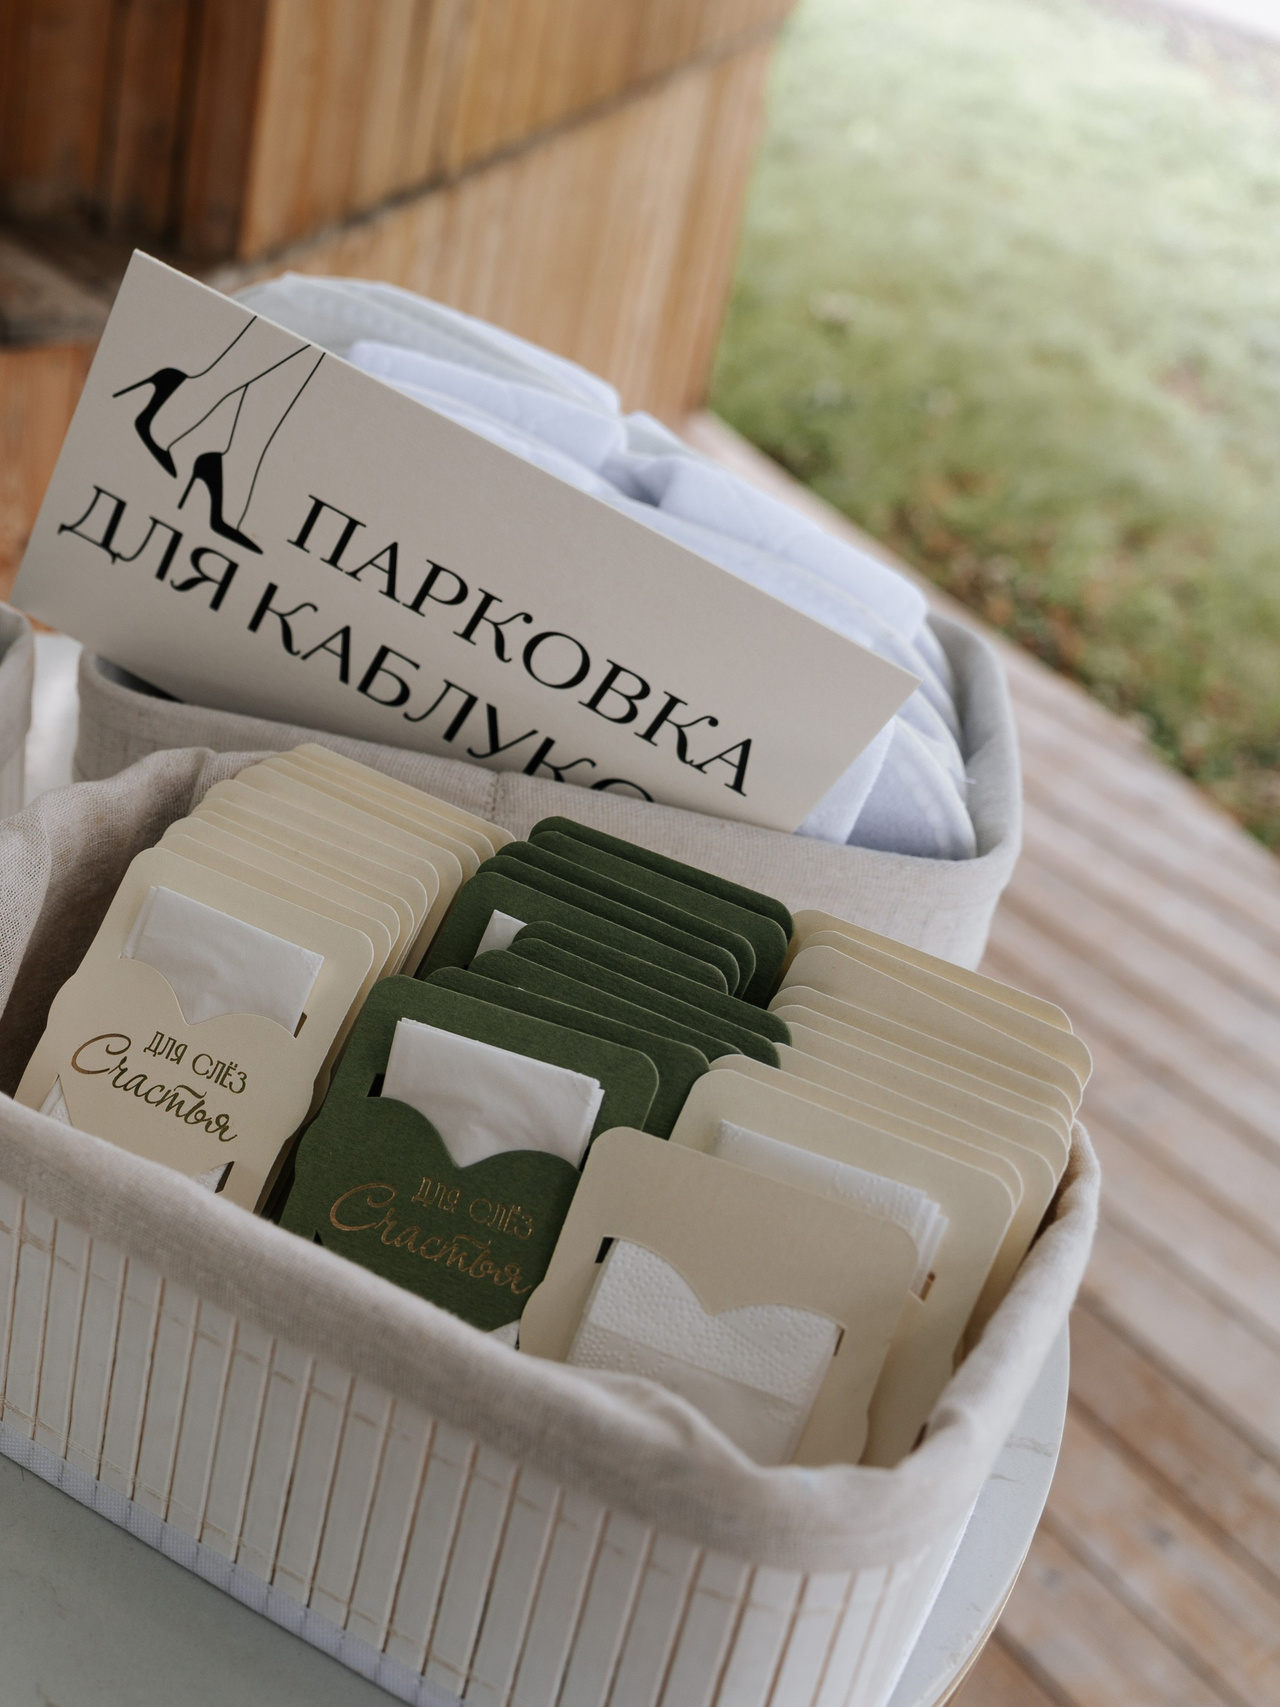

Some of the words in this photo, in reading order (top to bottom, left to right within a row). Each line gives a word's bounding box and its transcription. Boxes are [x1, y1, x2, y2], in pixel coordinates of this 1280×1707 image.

[58, 485, 240, 612] ДЛЯ
[287, 494, 756, 798] ПАРКОВКА
[70, 1032, 238, 1143] Счастья
[329, 1182, 522, 1295] Счастья
